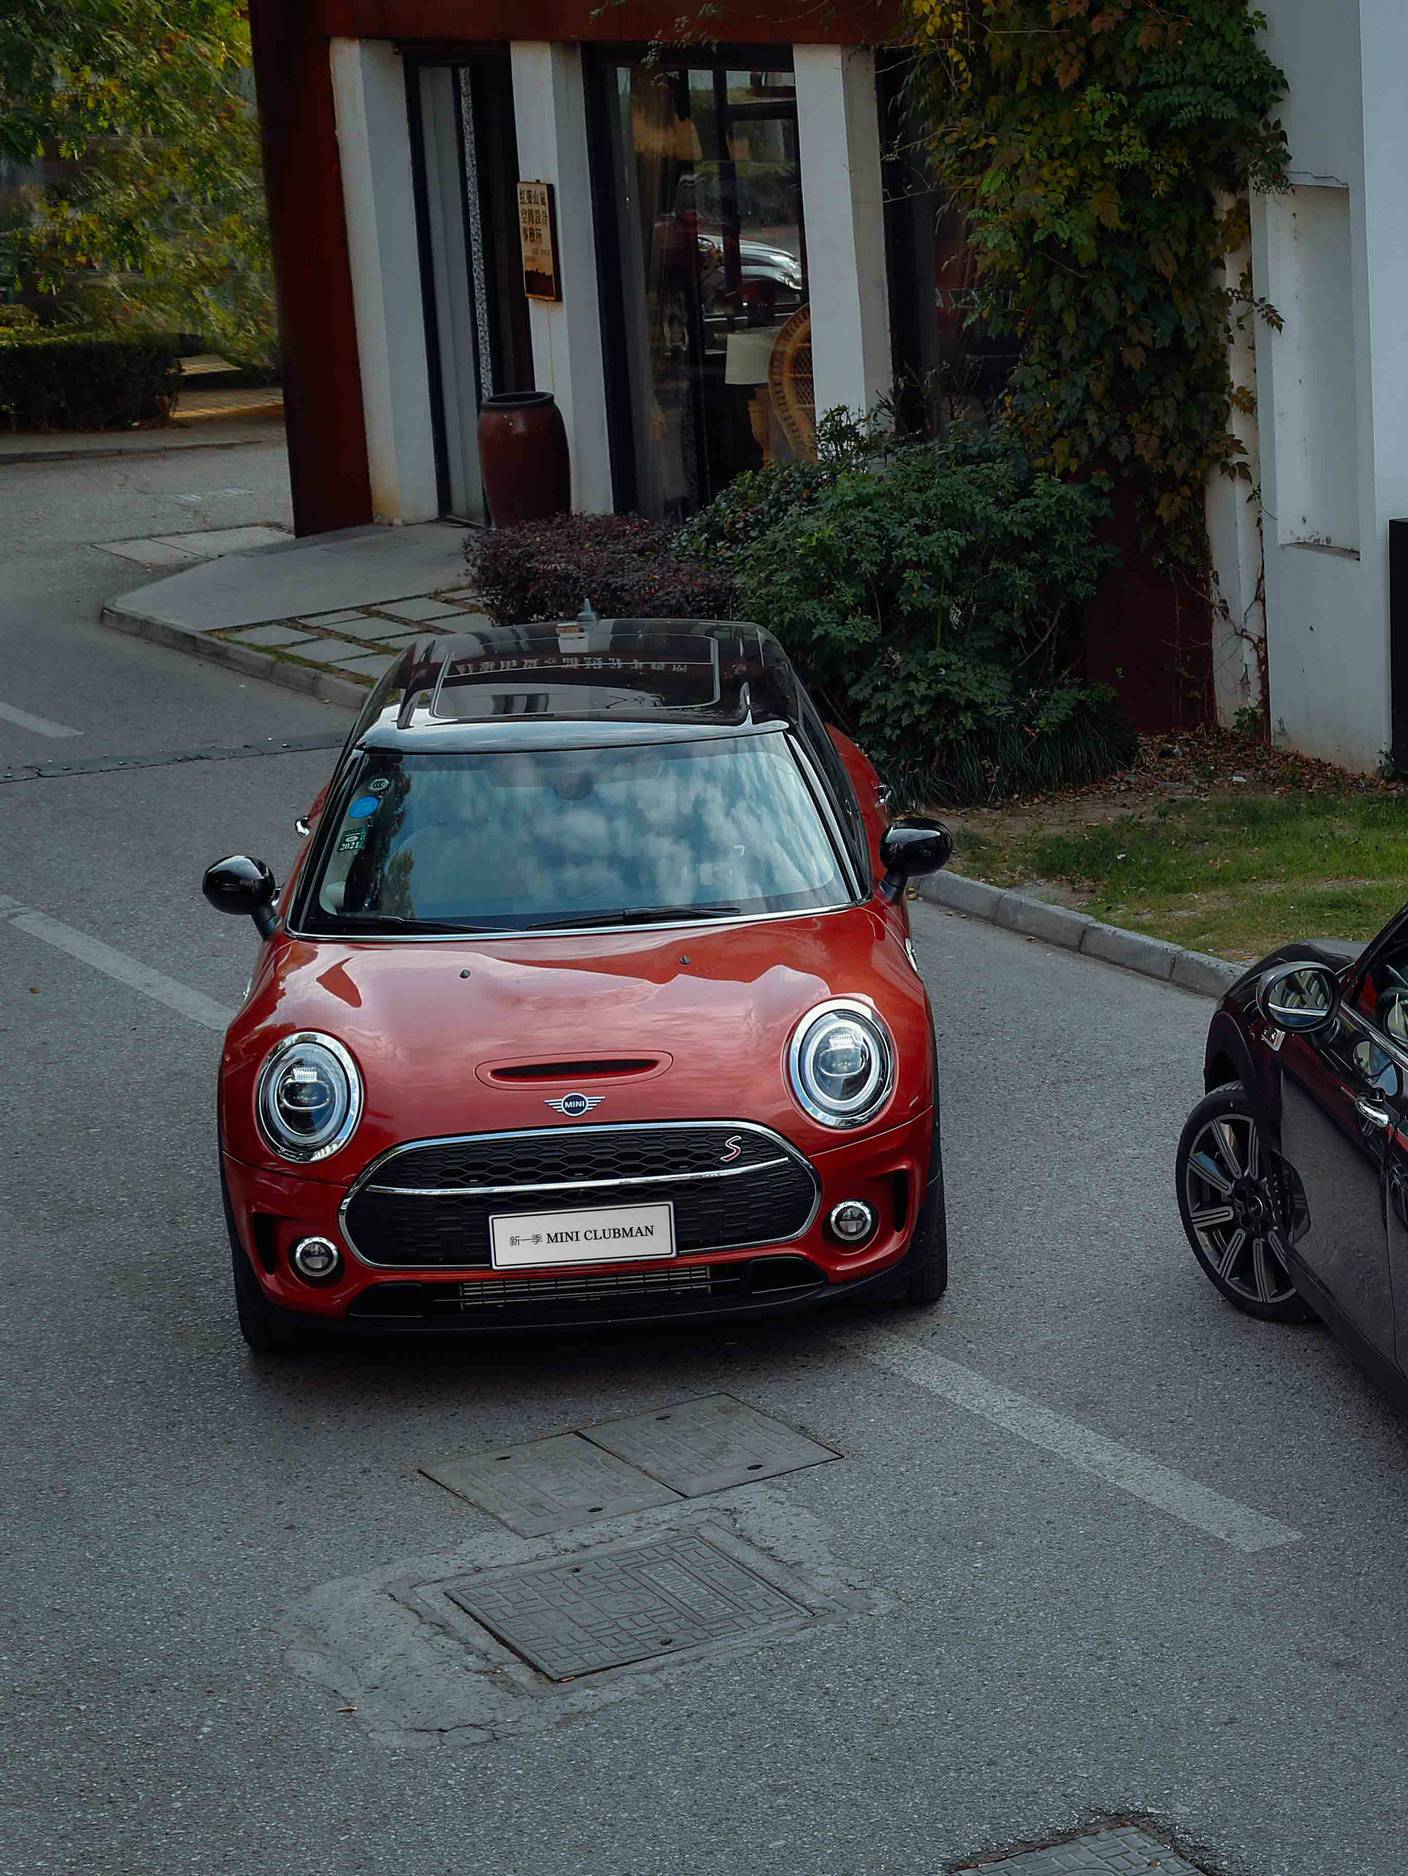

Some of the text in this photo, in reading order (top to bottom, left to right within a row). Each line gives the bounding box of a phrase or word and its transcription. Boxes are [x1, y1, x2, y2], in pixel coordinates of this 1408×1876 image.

[564, 1100, 585, 1109] MINI
[720, 1135, 742, 1163] S
[509, 1225, 655, 1247] 新一季 MINI CLUBMAN
